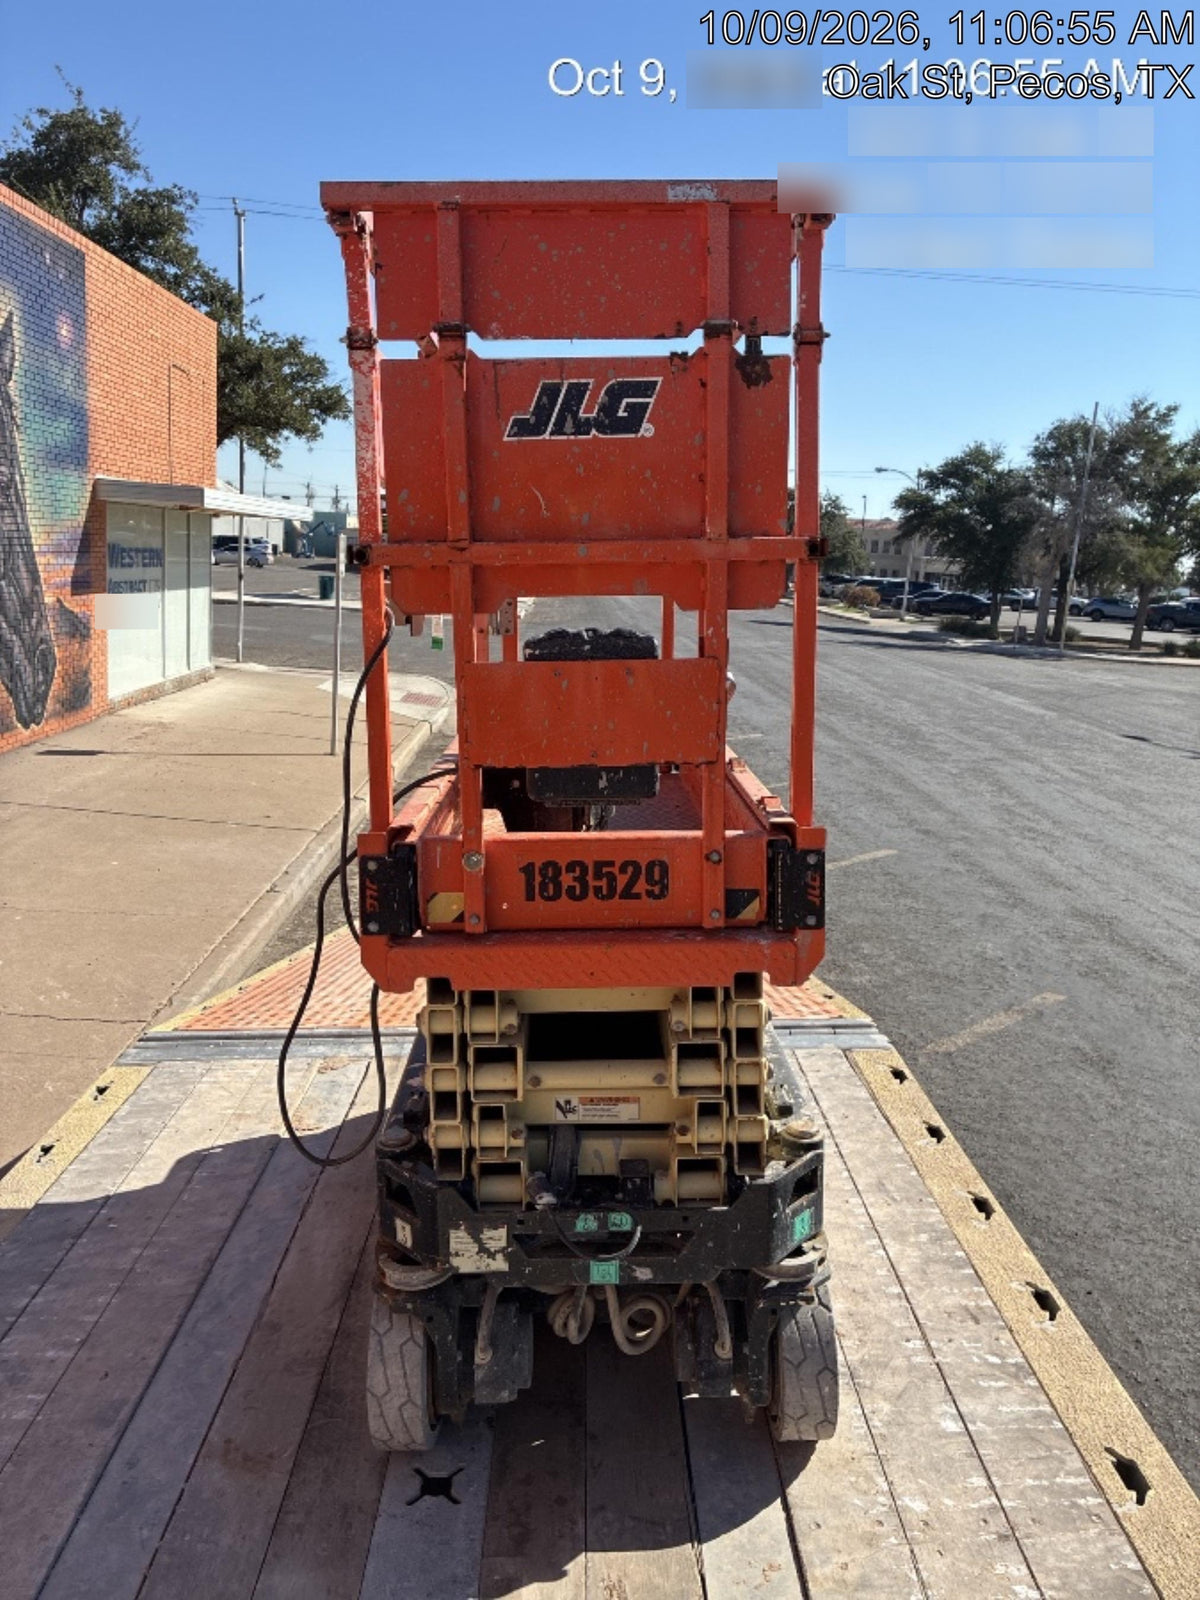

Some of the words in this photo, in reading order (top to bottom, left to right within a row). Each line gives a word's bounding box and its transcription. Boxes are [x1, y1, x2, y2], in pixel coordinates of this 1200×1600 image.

[503, 377, 663, 441] JLG
[108, 543, 163, 568] WESTERN
[518, 859, 670, 902] 183529
